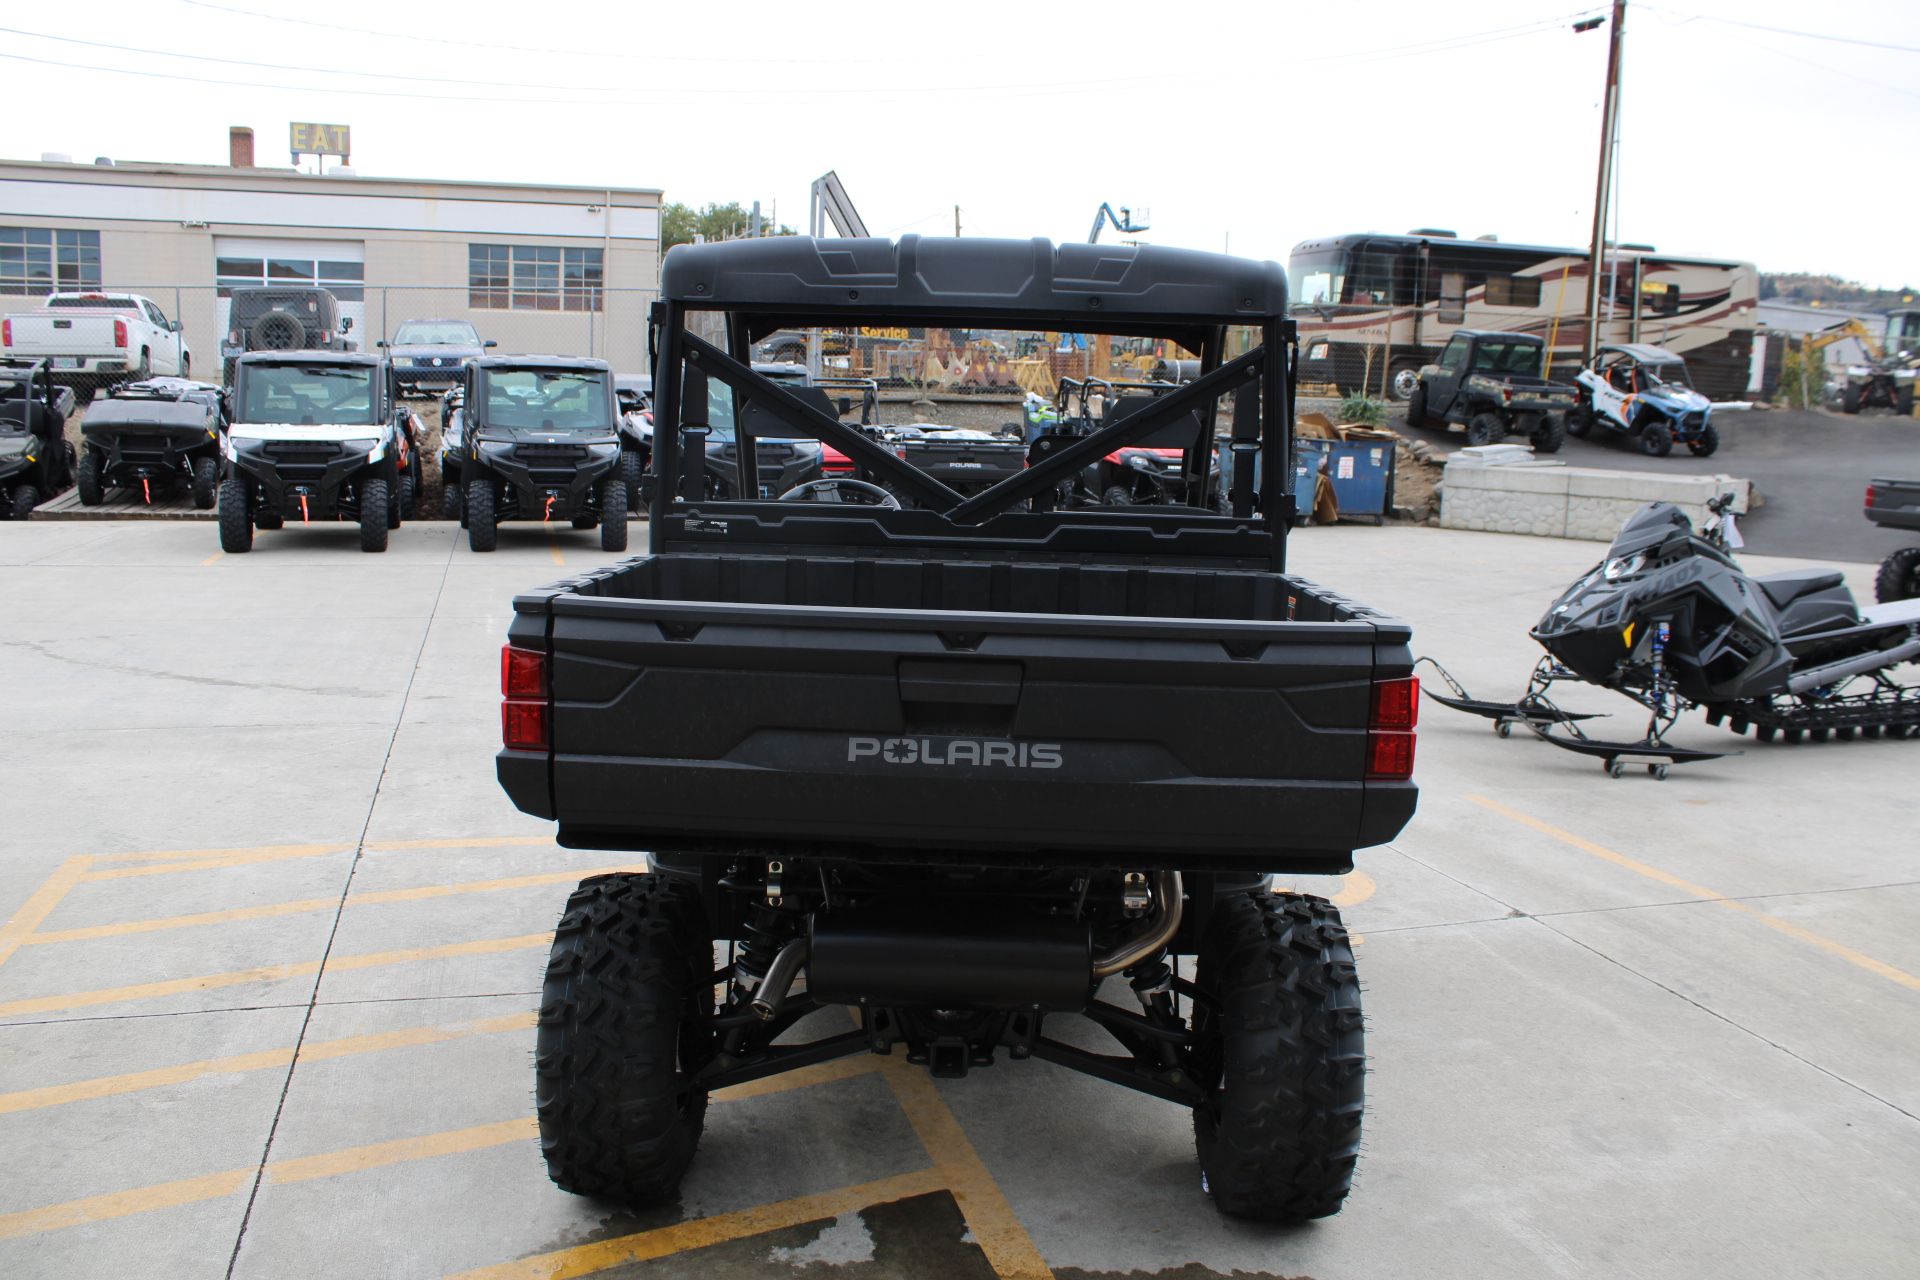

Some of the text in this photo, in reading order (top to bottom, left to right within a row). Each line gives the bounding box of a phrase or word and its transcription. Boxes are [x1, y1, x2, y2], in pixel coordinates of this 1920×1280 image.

[293, 123, 348, 152] EAT
[861, 326, 909, 339] Service
[847, 737, 1063, 769] POLARIS
